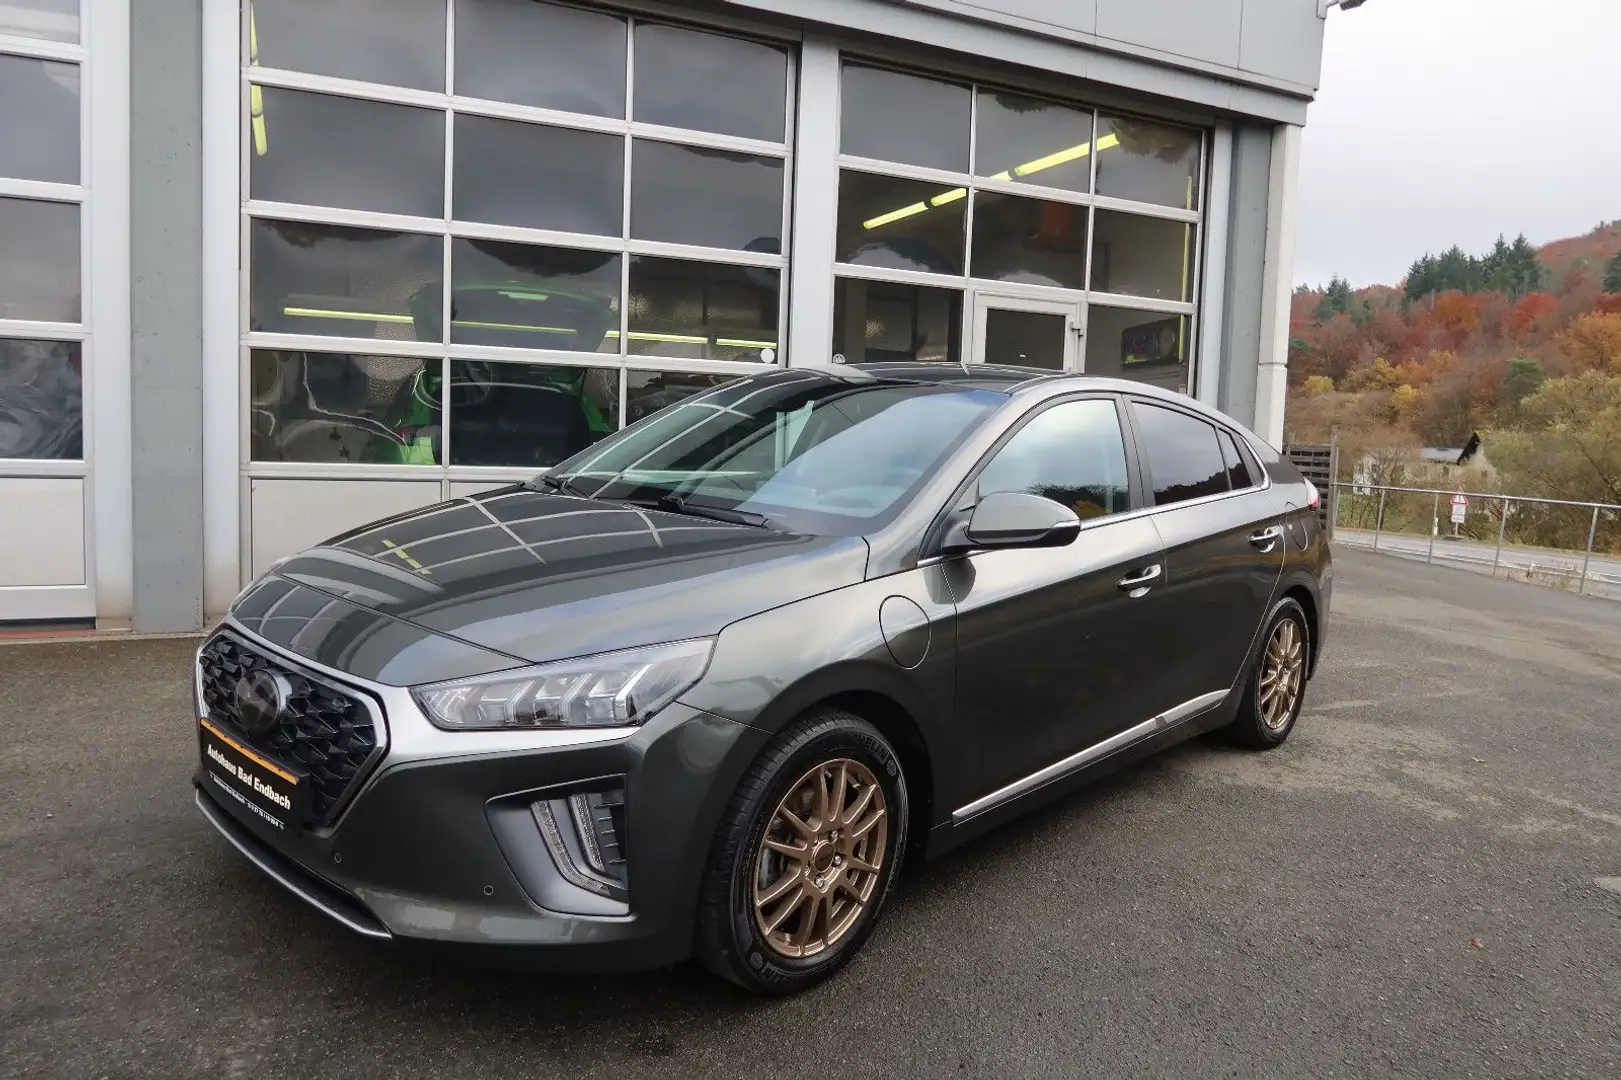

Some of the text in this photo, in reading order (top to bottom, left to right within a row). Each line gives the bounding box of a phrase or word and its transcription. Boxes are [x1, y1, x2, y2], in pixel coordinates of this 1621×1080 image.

[207, 743, 237, 775] Autohaus
[238, 765, 253, 786] Bad
[253, 777, 291, 810] Endbach
